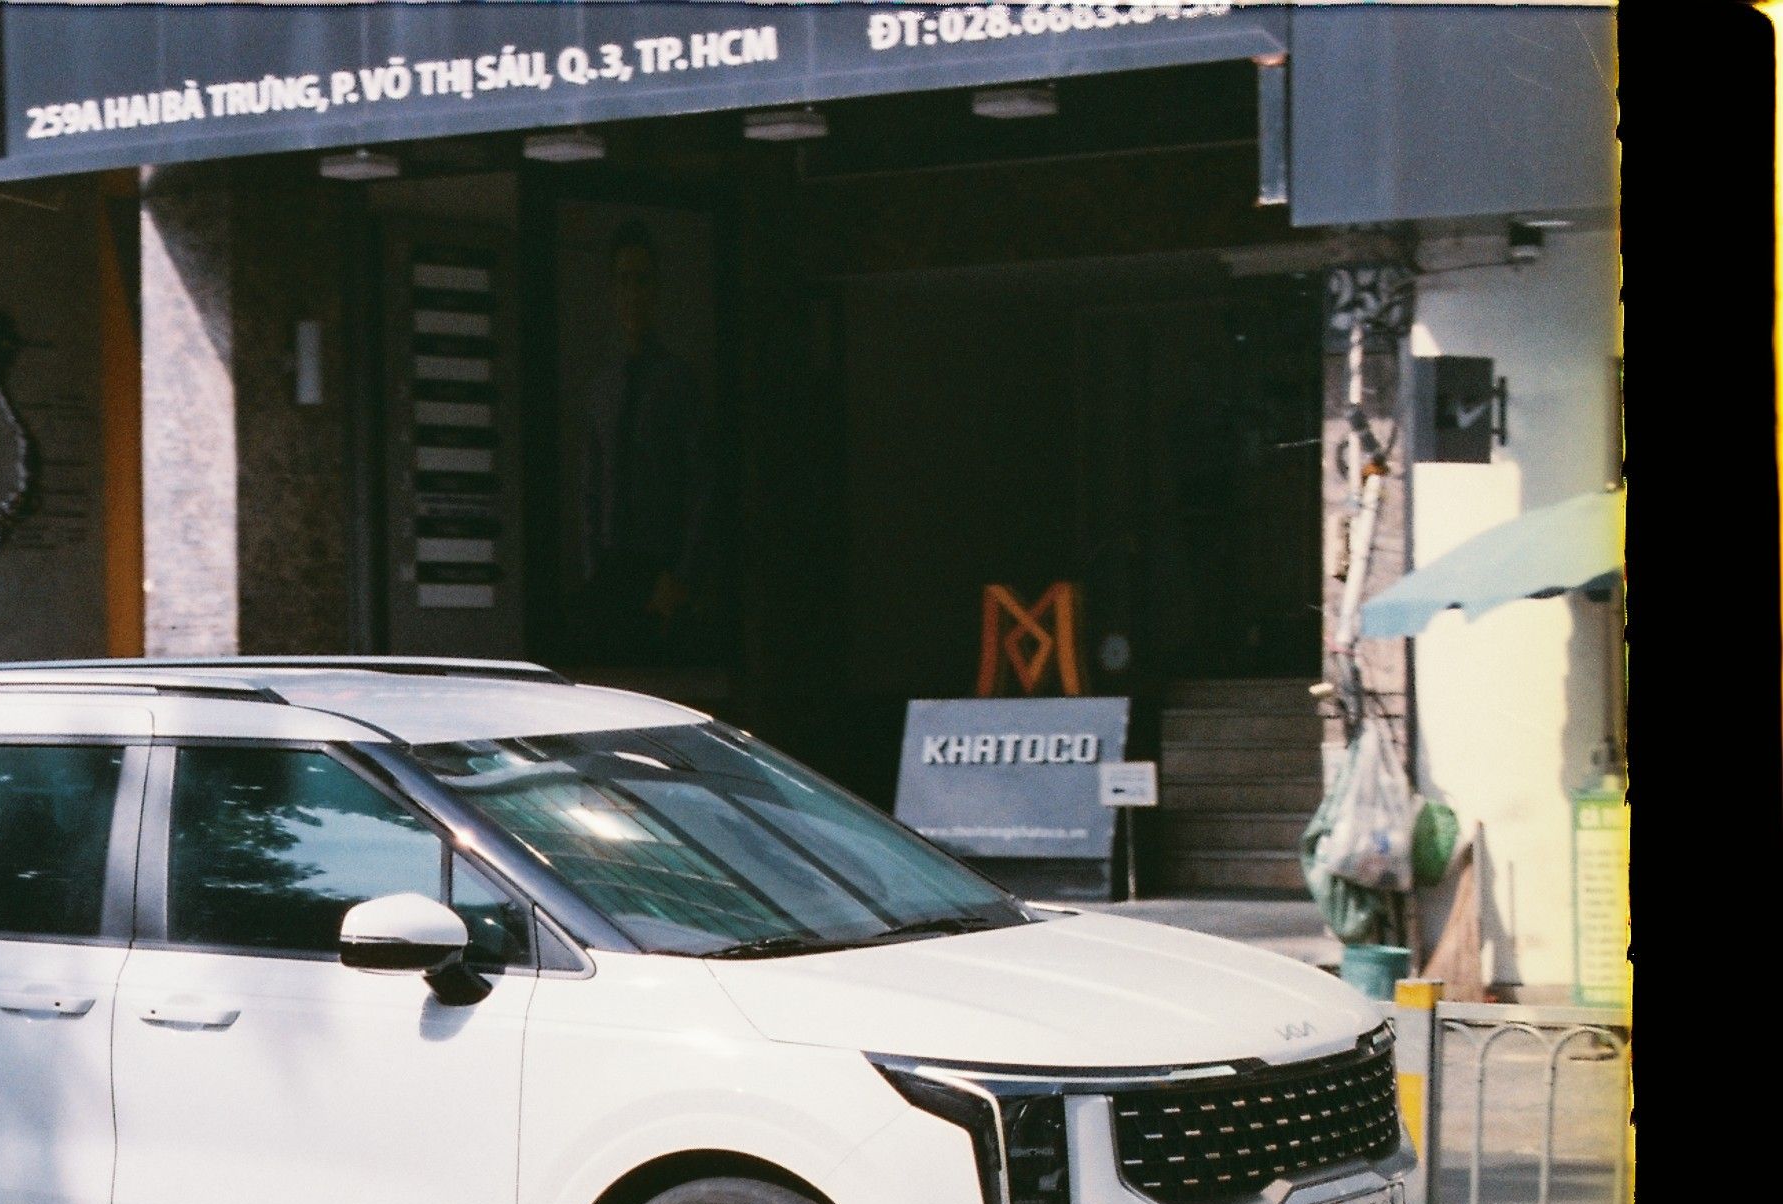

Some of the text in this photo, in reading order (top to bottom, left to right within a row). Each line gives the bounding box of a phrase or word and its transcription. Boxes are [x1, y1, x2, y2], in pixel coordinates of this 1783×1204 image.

[25, 99, 104, 140] 259A
[414, 57, 474, 100] THỊ
[921, 732, 1100, 765] KHATOCO
